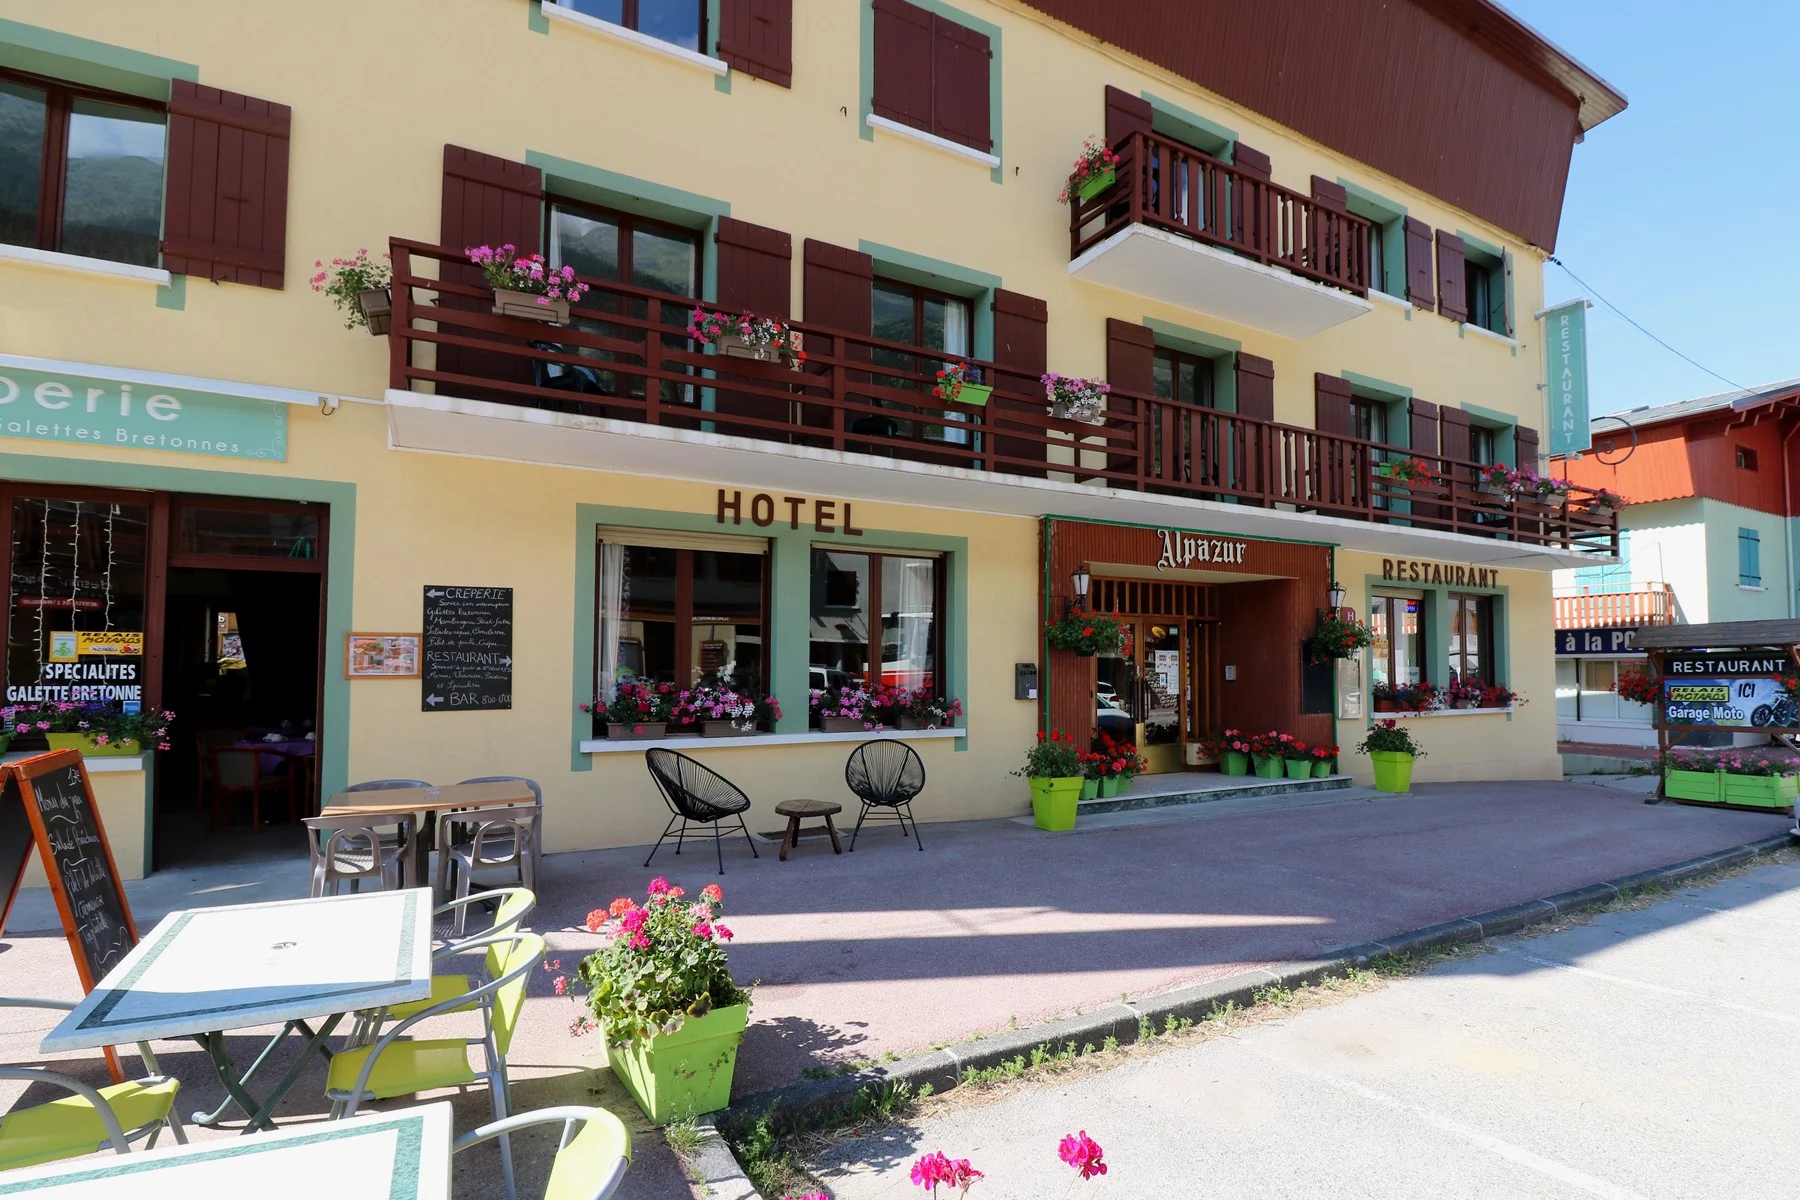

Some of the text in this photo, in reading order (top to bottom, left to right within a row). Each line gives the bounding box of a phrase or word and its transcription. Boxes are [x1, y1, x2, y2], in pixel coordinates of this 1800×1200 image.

[1560, 315, 1576, 444] RESTAURANT
[0, 418, 239, 453] alettes Bretonnes
[717, 489, 863, 536] HOTEL
[1157, 529, 1247, 571] Alpazur
[1383, 558, 1498, 589] RESTAURANT
[445, 588, 506, 600] CREPERIE
[1347, 611, 1355, 621] H
[1565, 632, 1576, 652] à
[1584, 632, 1602, 651] la
[426, 650, 501, 665] RESTAURANT
[45, 663, 136, 680] SPECIALITES
[1672, 660, 1785, 673] RESTAURANT
[6, 685, 141, 702] GALETTE BRETONNE
[1673, 693, 1726, 701] MOTARDS
[1738, 682, 1755, 698] ICI
[450, 692, 480, 706] BAR
[1668, 706, 1744, 721] Garage Moto
